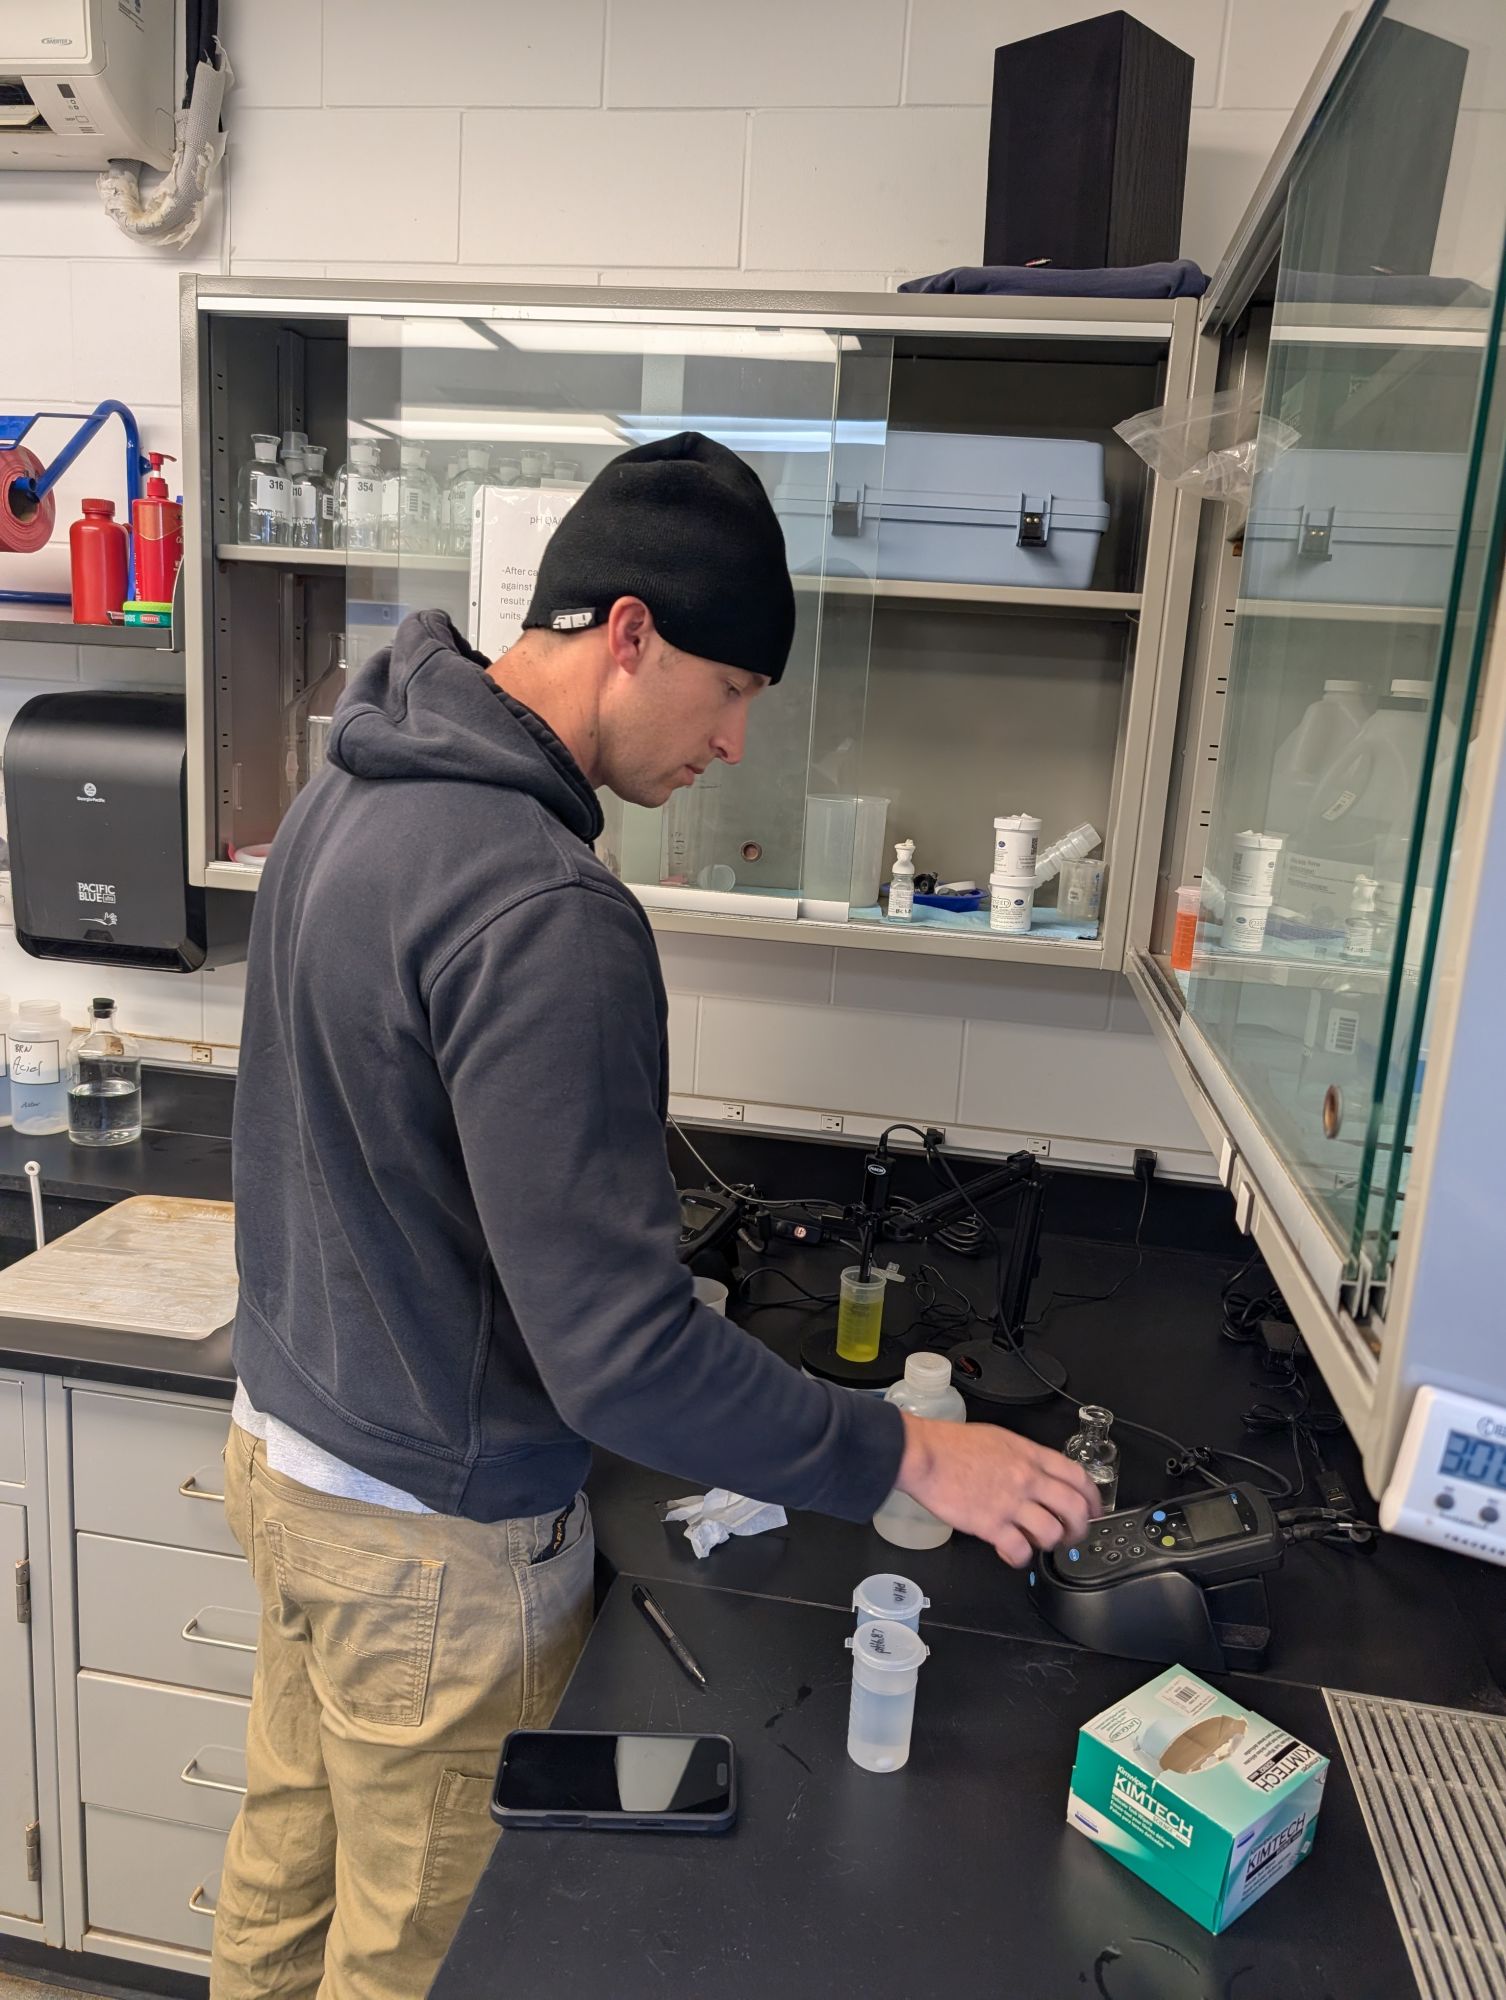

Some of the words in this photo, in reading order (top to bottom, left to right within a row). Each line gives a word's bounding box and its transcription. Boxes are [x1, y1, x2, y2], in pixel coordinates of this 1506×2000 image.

[269, 480, 284, 490] 316
[357, 482, 374, 492] 354
[529, 516, 543, 526] pH
[545, 516, 562, 526] QA/
[502, 566, 526, 576] -After
[501, 581, 532, 591] against
[500, 597, 526, 606] result
[78, 882, 116, 895] PACIFIC
[79, 891, 103, 903] BLUE
[1256, 1745, 1315, 1793] KIMTECH
[1117, 1764, 1148, 1791] Kimwipes
[1114, 1773, 1194, 1839] KIMTECH
[1246, 1812, 1306, 1874] KIMTECH
